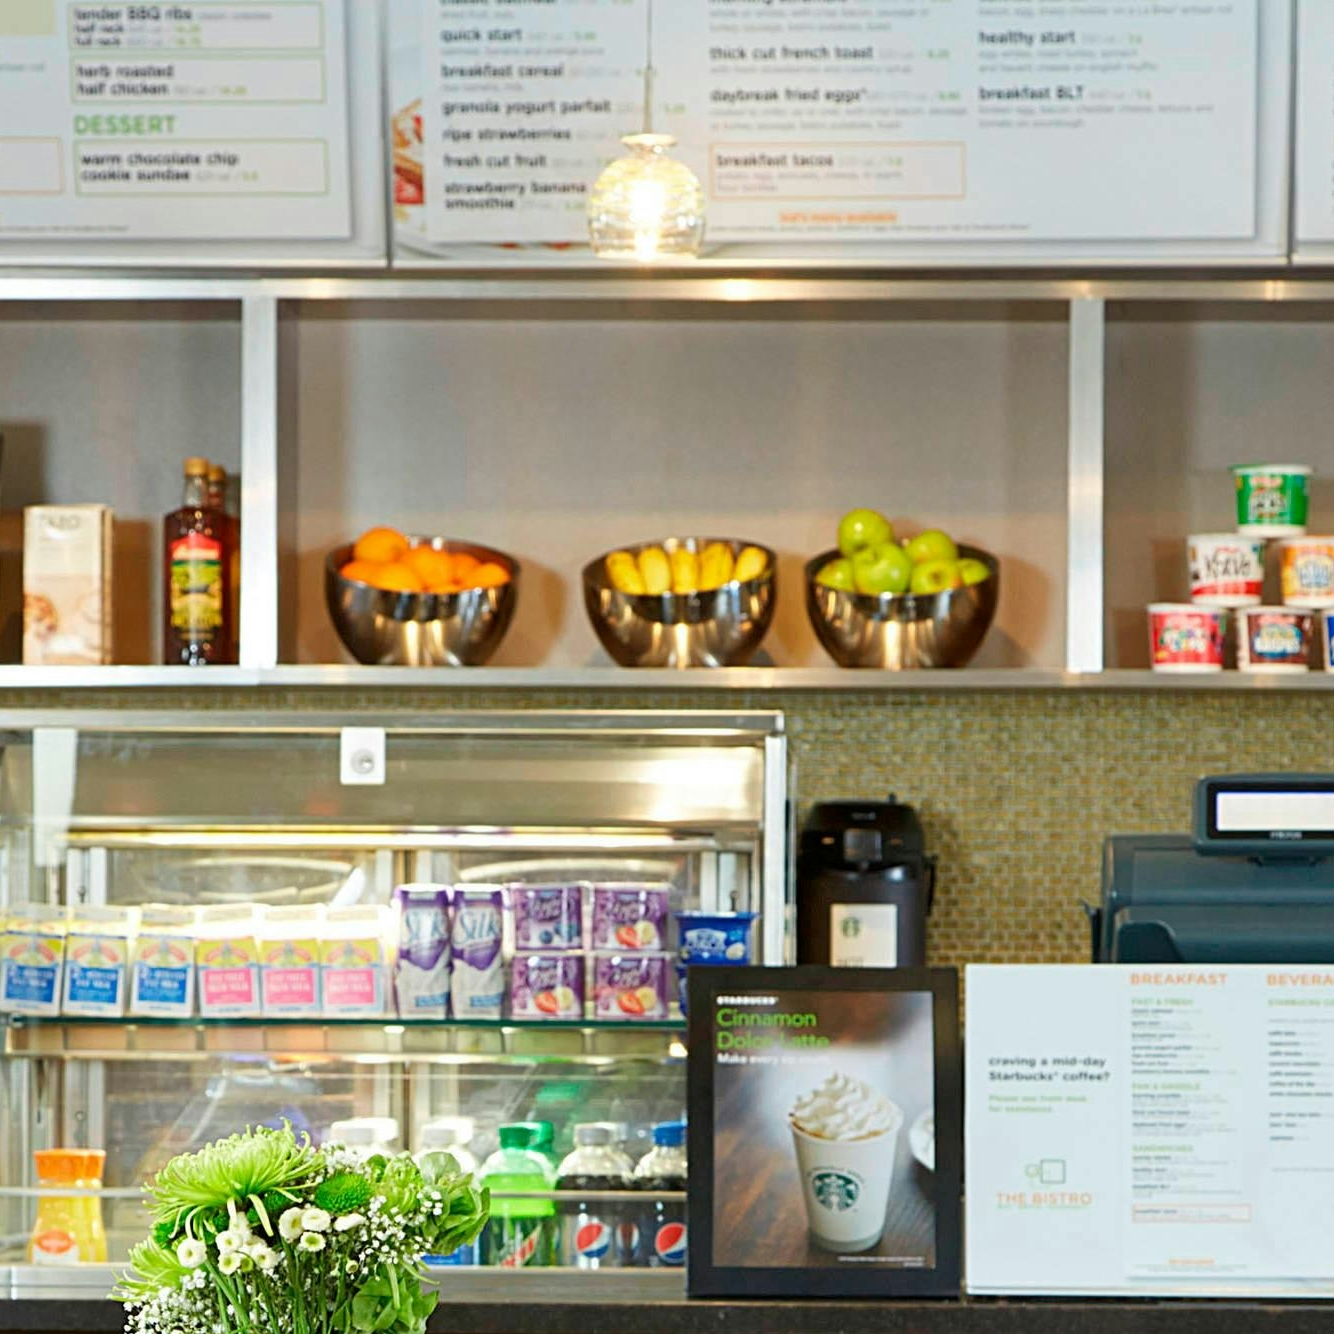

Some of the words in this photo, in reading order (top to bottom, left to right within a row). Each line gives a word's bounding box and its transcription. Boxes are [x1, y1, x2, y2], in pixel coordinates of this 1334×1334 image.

[127, 7, 161, 21] BBQ
[440, 29, 482, 43] quick
[487, 28, 523, 41] start
[978, 31, 1035, 45] healthy
[1040, 30, 1076, 43] start
[709, 47, 747, 59] thick
[752, 48, 777, 59] cut
[781, 47, 830, 59] french
[834, 47, 874, 59] toast
[441, 64, 513, 78] breakfast
[518, 64, 565, 77] cereal
[110, 82, 169, 95] chicken
[978, 86, 1051, 100] breakfast
[1056, 86, 1085, 99] BLT
[710, 89, 779, 104] daybreak
[784, 89, 820, 101] fried
[442, 101, 501, 115] granola
[505, 101, 556, 116] yogurt
[560, 100, 612, 115] parfait
[73, 115, 176, 135] DESSERT
[477, 128, 572, 140] strawberries
[127, 153, 201, 165] chocolate
[206, 153, 240, 169] chip
[716, 155, 788, 168] breakfast
[792, 155, 834, 168] tacos
[80, 169, 131, 181] cookie
[444, 182, 526, 196] strawberry
[530, 181, 587, 194] banana
[1130, 972, 1227, 986] BREAKFAST
[717, 1008, 817, 1028] Cinnamon
[717, 1054, 749, 1064] Make
[988, 1056, 1037, 1068] craving
[1041, 1058, 1048, 1066] a
[1052, 1055, 1107, 1068] mid-day
[1062, 1071, 1111, 1082] coffee?
[996, 1192, 1027, 1206] THE
[1031, 1192, 1093, 1206] BISTRO
